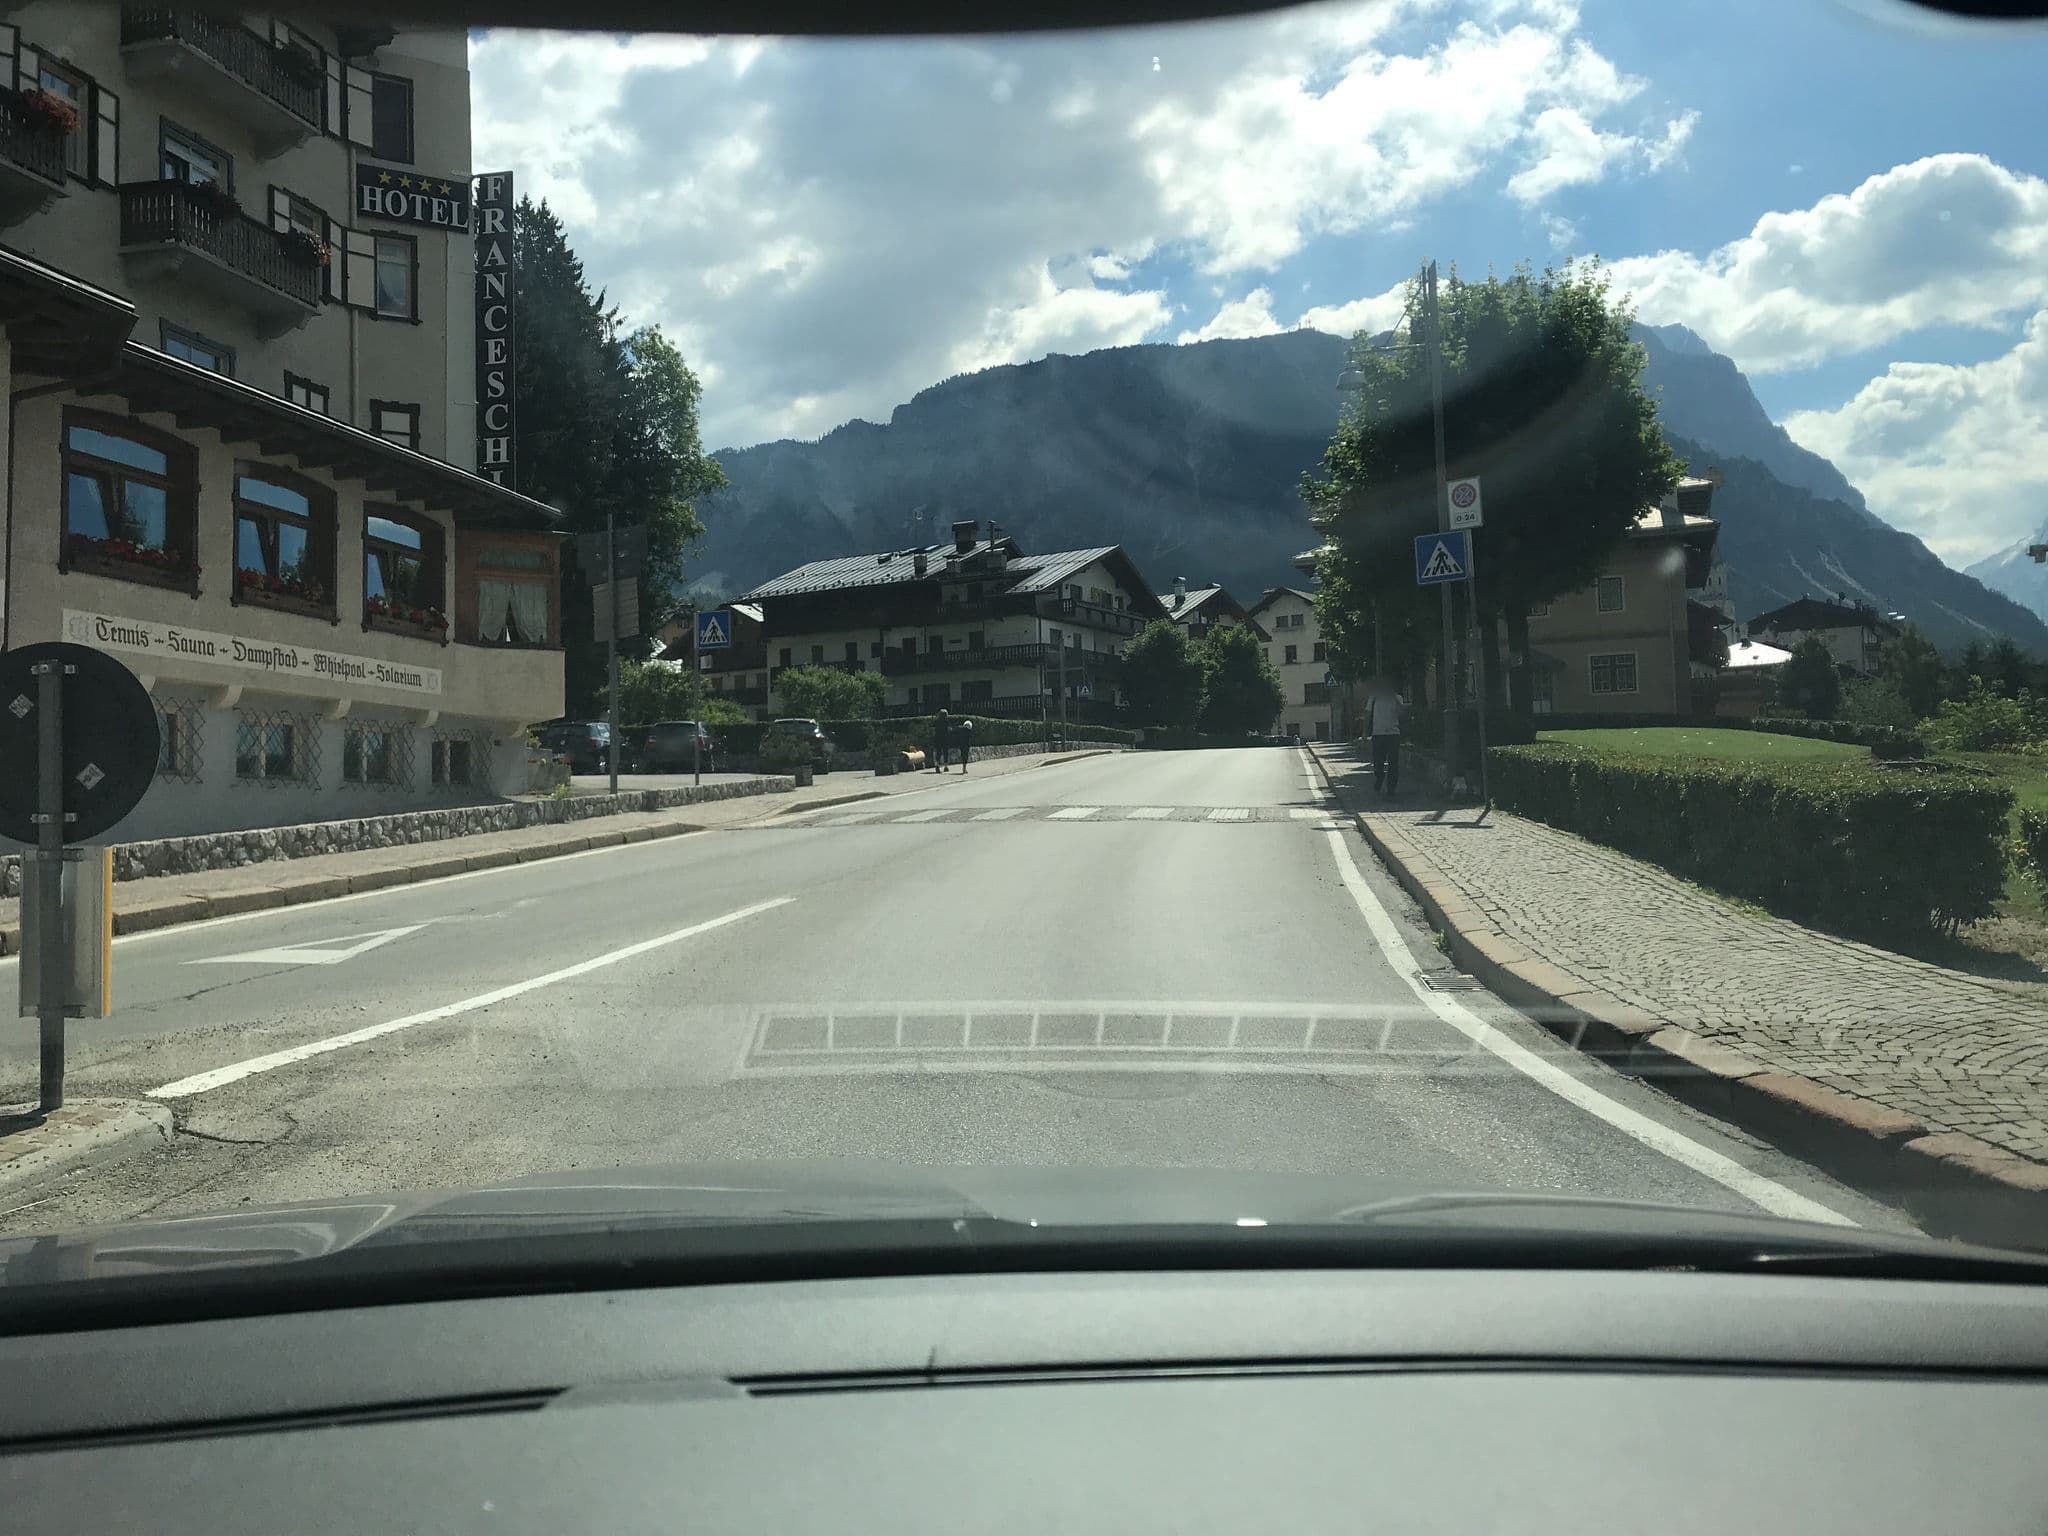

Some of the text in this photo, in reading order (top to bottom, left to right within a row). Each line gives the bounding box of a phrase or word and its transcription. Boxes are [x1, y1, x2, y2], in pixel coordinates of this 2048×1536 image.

[361, 184, 468, 228] HOTEL
[95, 616, 422, 687] Tennis Sauna Dampfbad Whirlpool Solarium
